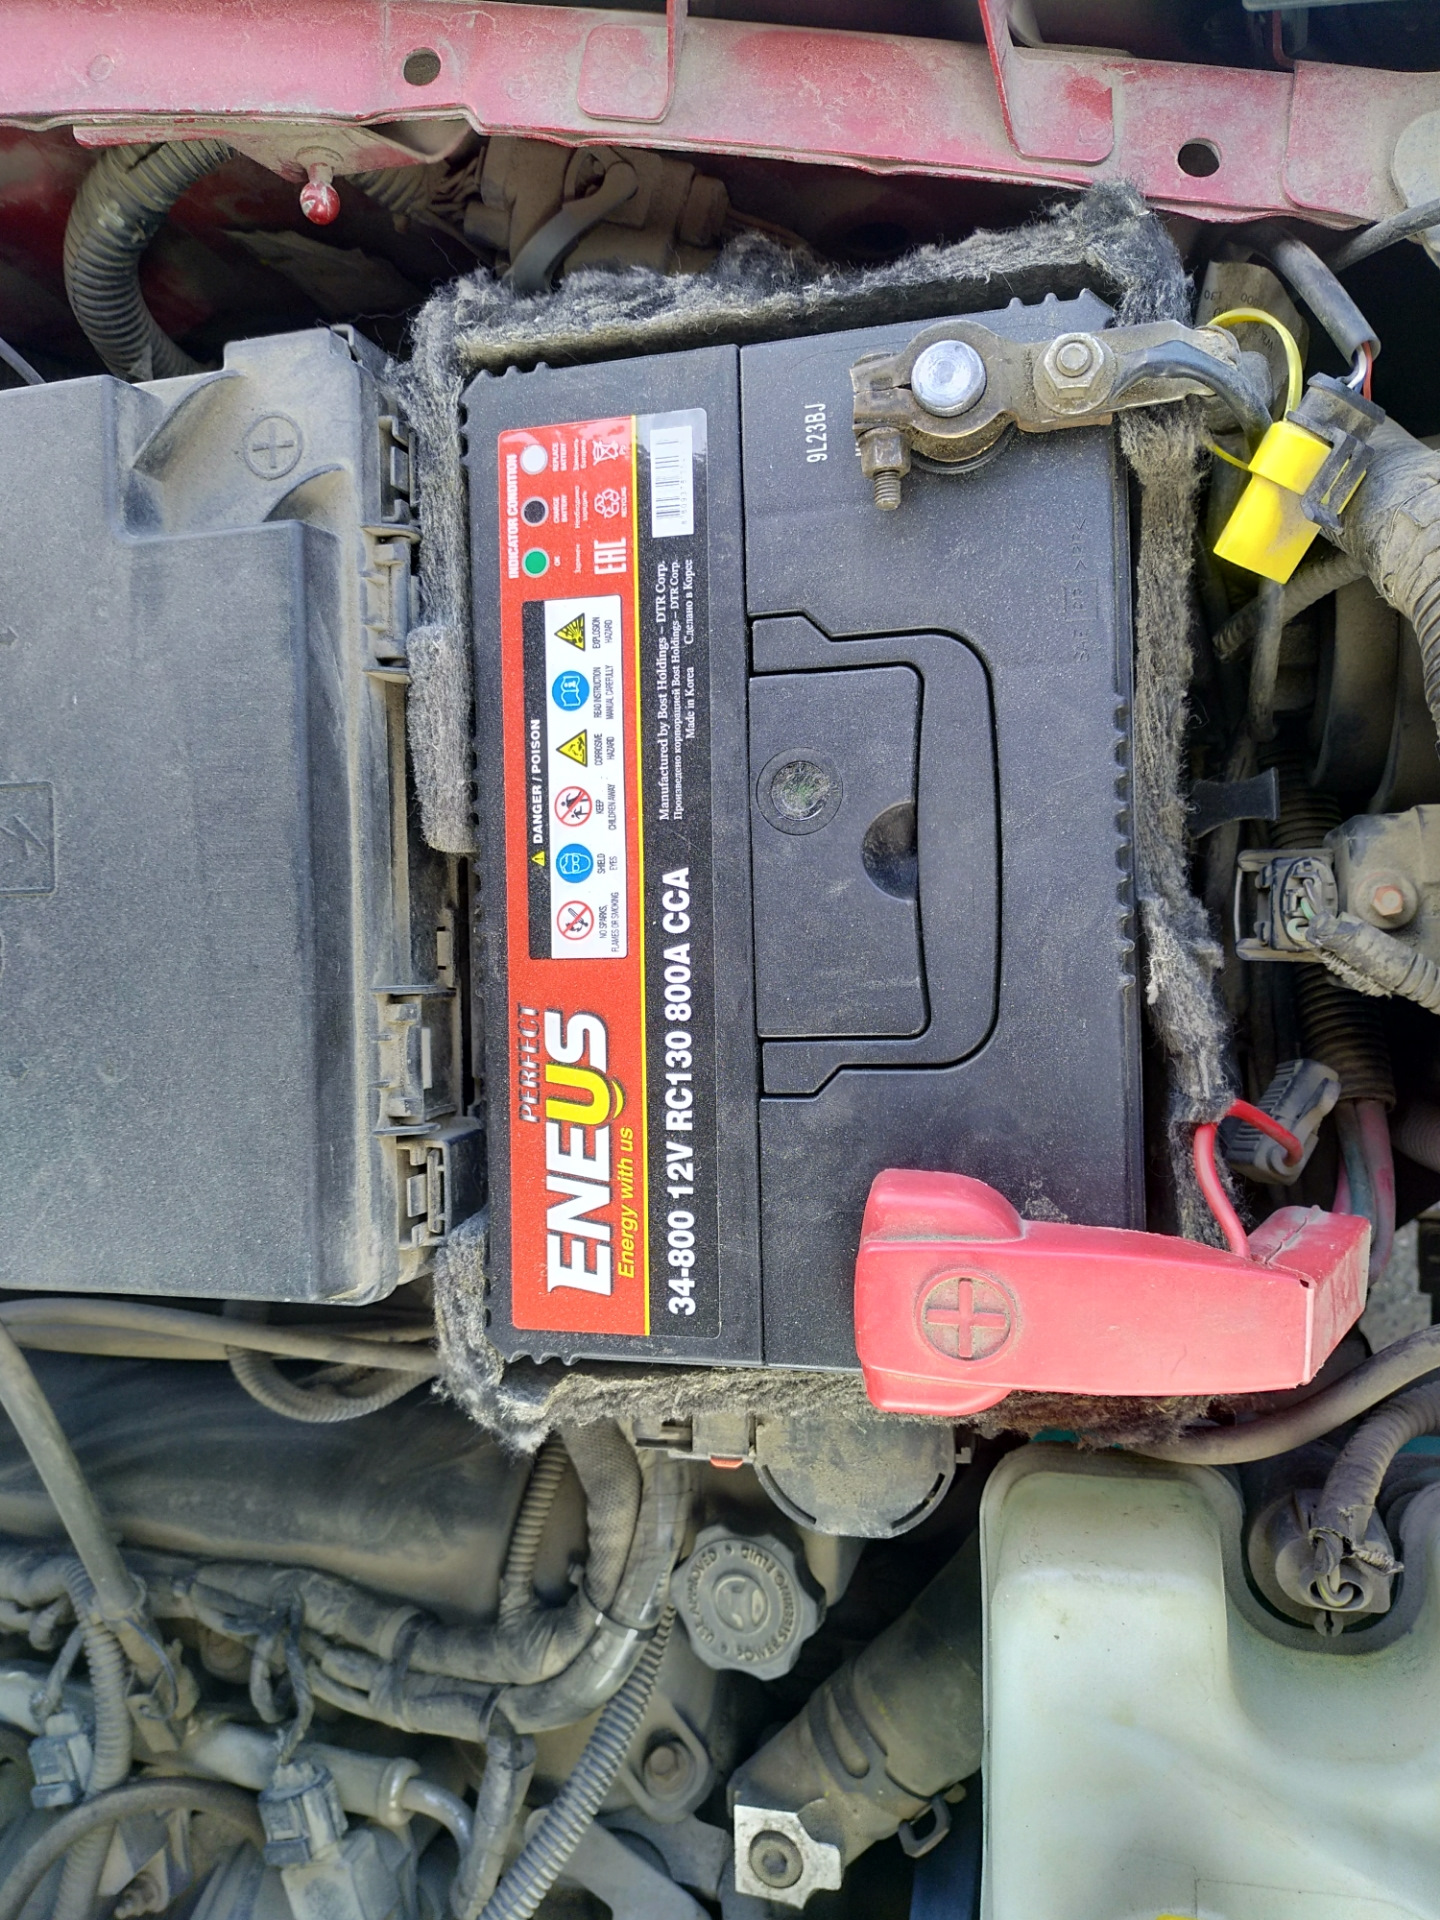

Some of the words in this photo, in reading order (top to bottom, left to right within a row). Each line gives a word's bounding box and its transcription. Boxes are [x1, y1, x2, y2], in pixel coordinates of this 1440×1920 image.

[803, 403, 828, 463] 9L23BJ
[552, 442, 560, 472] REPLACE
[506, 454, 518, 516] CONDITION
[552, 496, 560, 524] CHARGE
[560, 494, 568, 523] BATTERY
[573, 485, 581, 529] Необходимо
[507, 517, 519, 579] INDICATOR
[554, 555, 561, 567] OK
[655, 560, 669, 593] Corp.
[670, 560, 681, 585] Corp.
[683, 560, 695, 590] Корее
[655, 594, 667, 623] DTR
[670, 586, 680, 609] DTR
[592, 616, 601, 649] EXPLOSION
[604, 619, 613, 644] HAZARD
[683, 600, 694, 645] Сделано
[670, 620, 681, 663] Holdings
[655, 637, 669, 692] Holdings
[671, 665, 681, 687] Bost
[592, 666, 602, 702] INSTRUCTION
[604, 664, 614, 696] CAREFULLY
[684, 666, 695, 697] Korea
[593, 702, 602, 718] READ
[605, 696, 614, 720] MANUAL
[656, 693, 669, 719] Bost
[685, 699, 695, 709] in
[658, 721, 672, 735] by
[671, 688, 683, 754] корпорацией
[685, 711, 695, 739] Made
[530, 719, 541, 774] POISON
[594, 732, 603, 766] CORROSIVE
[606, 736, 615, 760] HAZARD
[607, 783, 616, 800] AWAY
[657, 738, 671, 821] Manufactured
[673, 755, 684, 820] Произведено
[532, 784, 544, 844] DANGER
[595, 799, 604, 815] KEEP
[608, 800, 617, 831] CHILDREN
[597, 853, 606, 875] SHIELD
[609, 855, 618, 871] EYES
[610, 891, 619, 919] SMOKING
[661, 866, 691, 935] CCA
[598, 905, 608, 929] SPARKS,
[611, 919, 619, 928] OR
[599, 929, 607, 939] NO
[611, 928, 620, 953] FLAMES
[663, 942, 692, 1022] 800A
[517, 1002, 540, 1123] PERFECT
[664, 1031, 694, 1132] RC130
[543, 1010, 614, 1297] ENEUS
[619, 1126, 634, 1153] us
[616, 1157, 634, 1200] with
[665, 1140, 695, 1200] 12V
[617, 1203, 639, 1279] Energy
[666, 1211, 696, 1316] 34-800
[740, 1544, 776, 1573] FLUID
[686, 1547, 718, 1616] APPROVED
[774, 1572, 796, 1640] STEERING
[694, 1618, 715, 1644] USE
[736, 1637, 780, 1662] POWER
